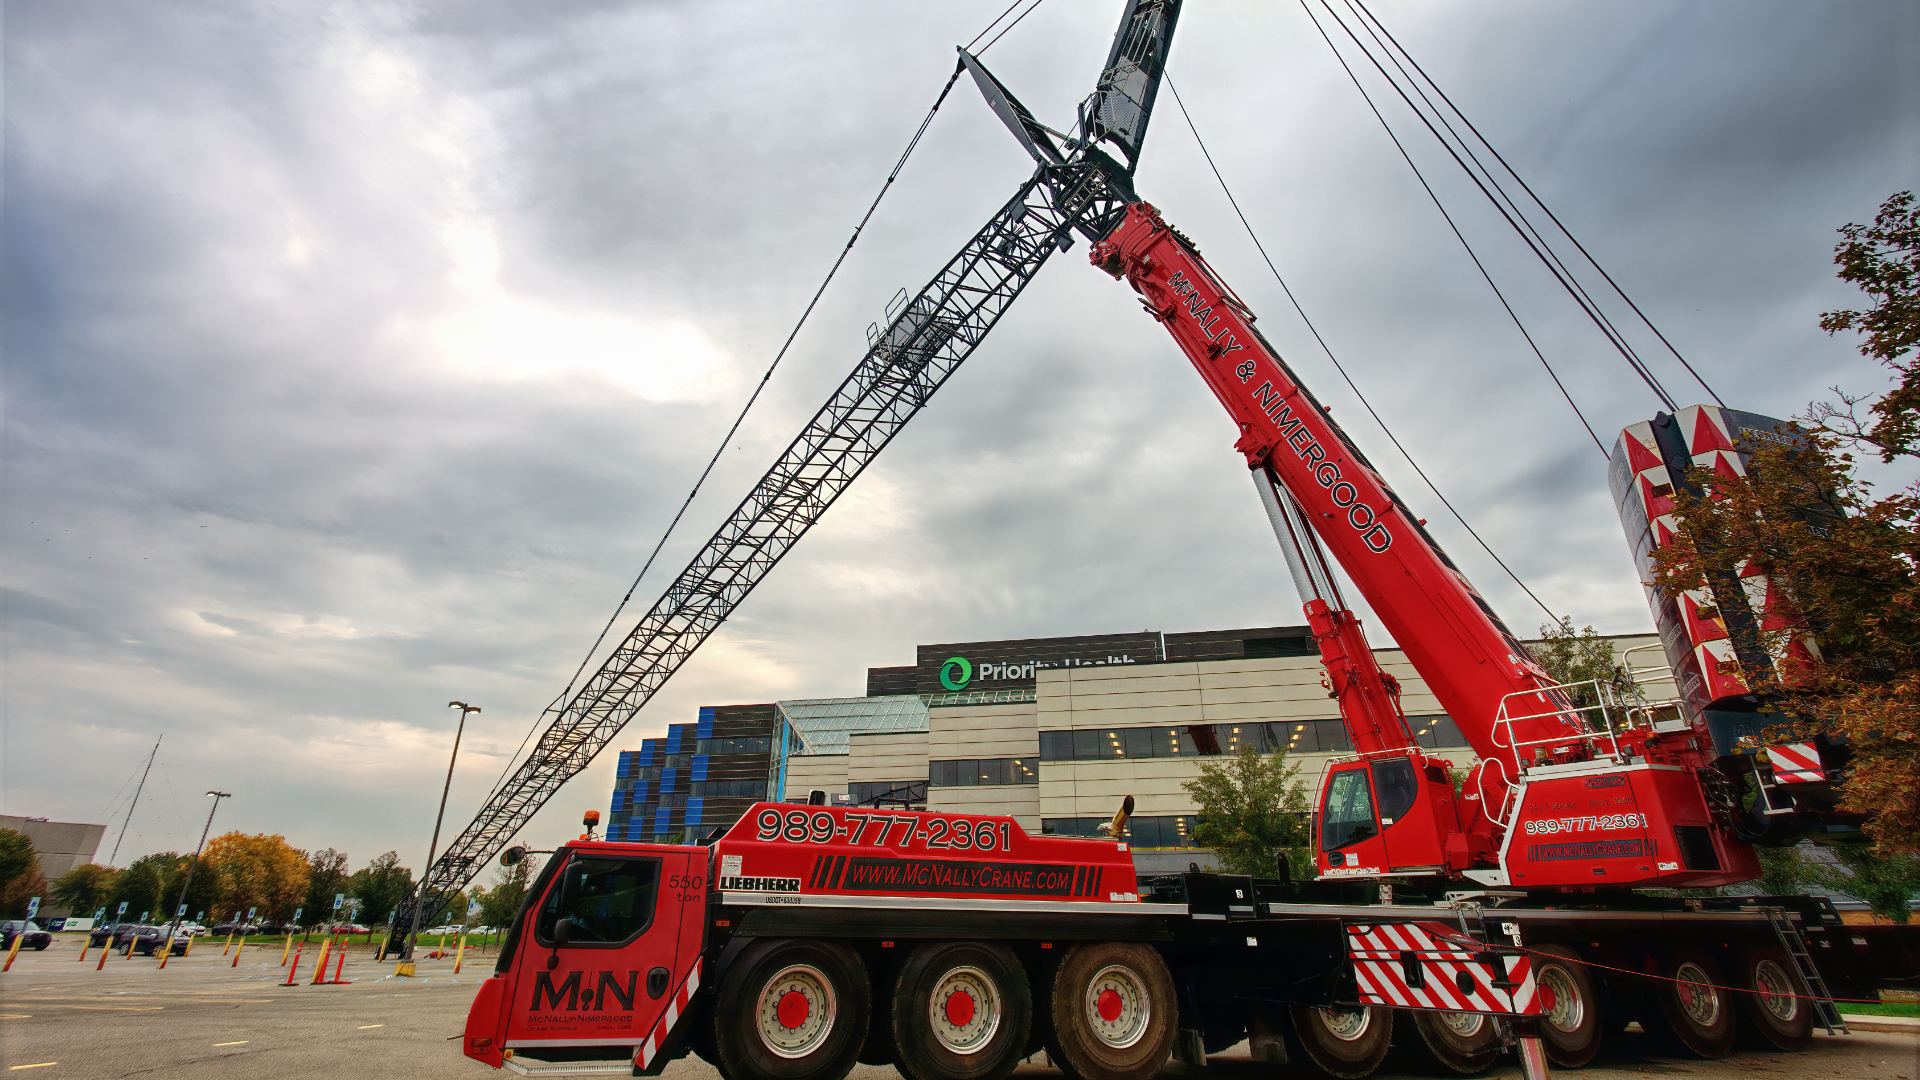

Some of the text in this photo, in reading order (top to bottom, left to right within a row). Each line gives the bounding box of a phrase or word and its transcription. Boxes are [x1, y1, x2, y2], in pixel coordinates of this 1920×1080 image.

[1235, 359, 1257, 383] &
[1251, 379, 1393, 554] NIMERGOOD
[757, 809, 1010, 851] 989-777-2361
[1525, 813, 1648, 834] 989-777-2361
[669, 875, 702, 890] 550
[719, 875, 801, 892] LIEBHERR
[676, 892, 701, 903] ton
